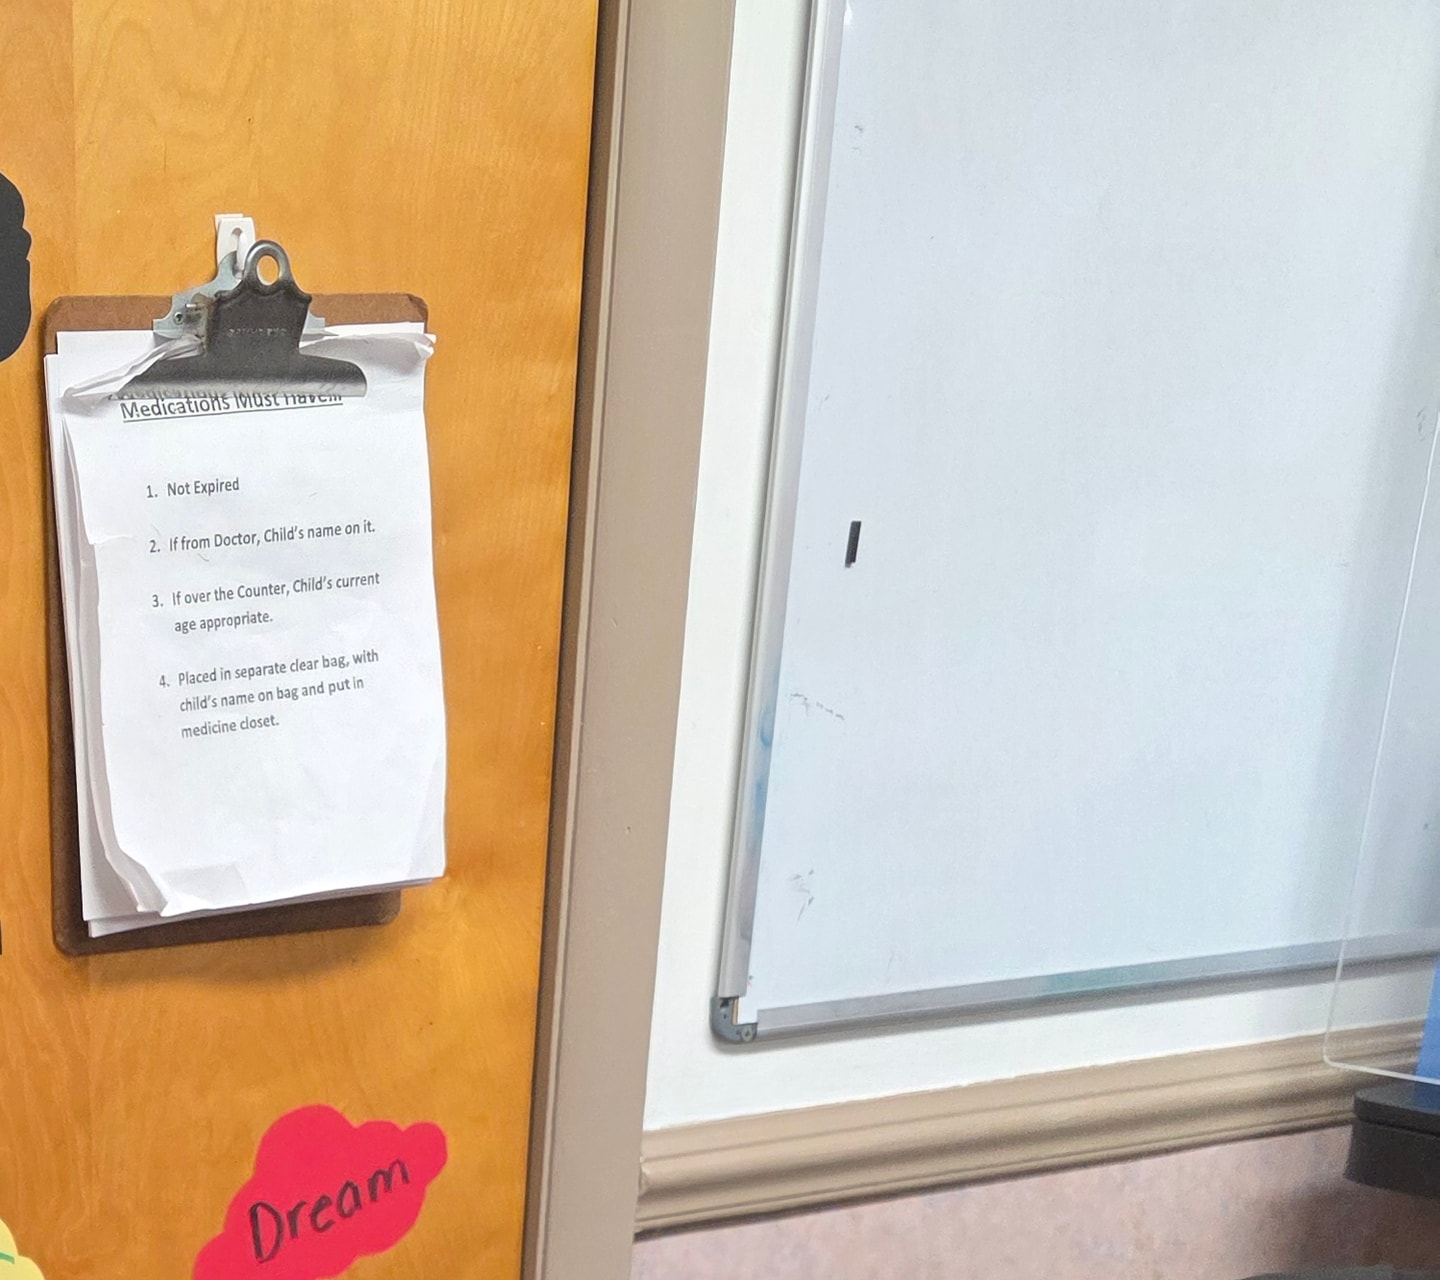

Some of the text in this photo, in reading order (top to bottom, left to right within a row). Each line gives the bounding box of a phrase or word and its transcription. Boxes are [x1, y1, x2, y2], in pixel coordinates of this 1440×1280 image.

[120, 394, 230, 420] Medications
[146, 477, 240, 498] 1. Not Expired
[150, 519, 375, 553] 2. If from Doctor, Child's name on it.
[152, 573, 380, 608] 3. If over the Counter, Child's current
[174, 611, 273, 634] age appropriate.
[159, 649, 379, 688] 4. Placed in separate clear bag, with
[179, 676, 364, 712] child's name on bag and put in
[181, 714, 279, 739] medicine closet.
[249, 1158, 410, 1265] Dream
